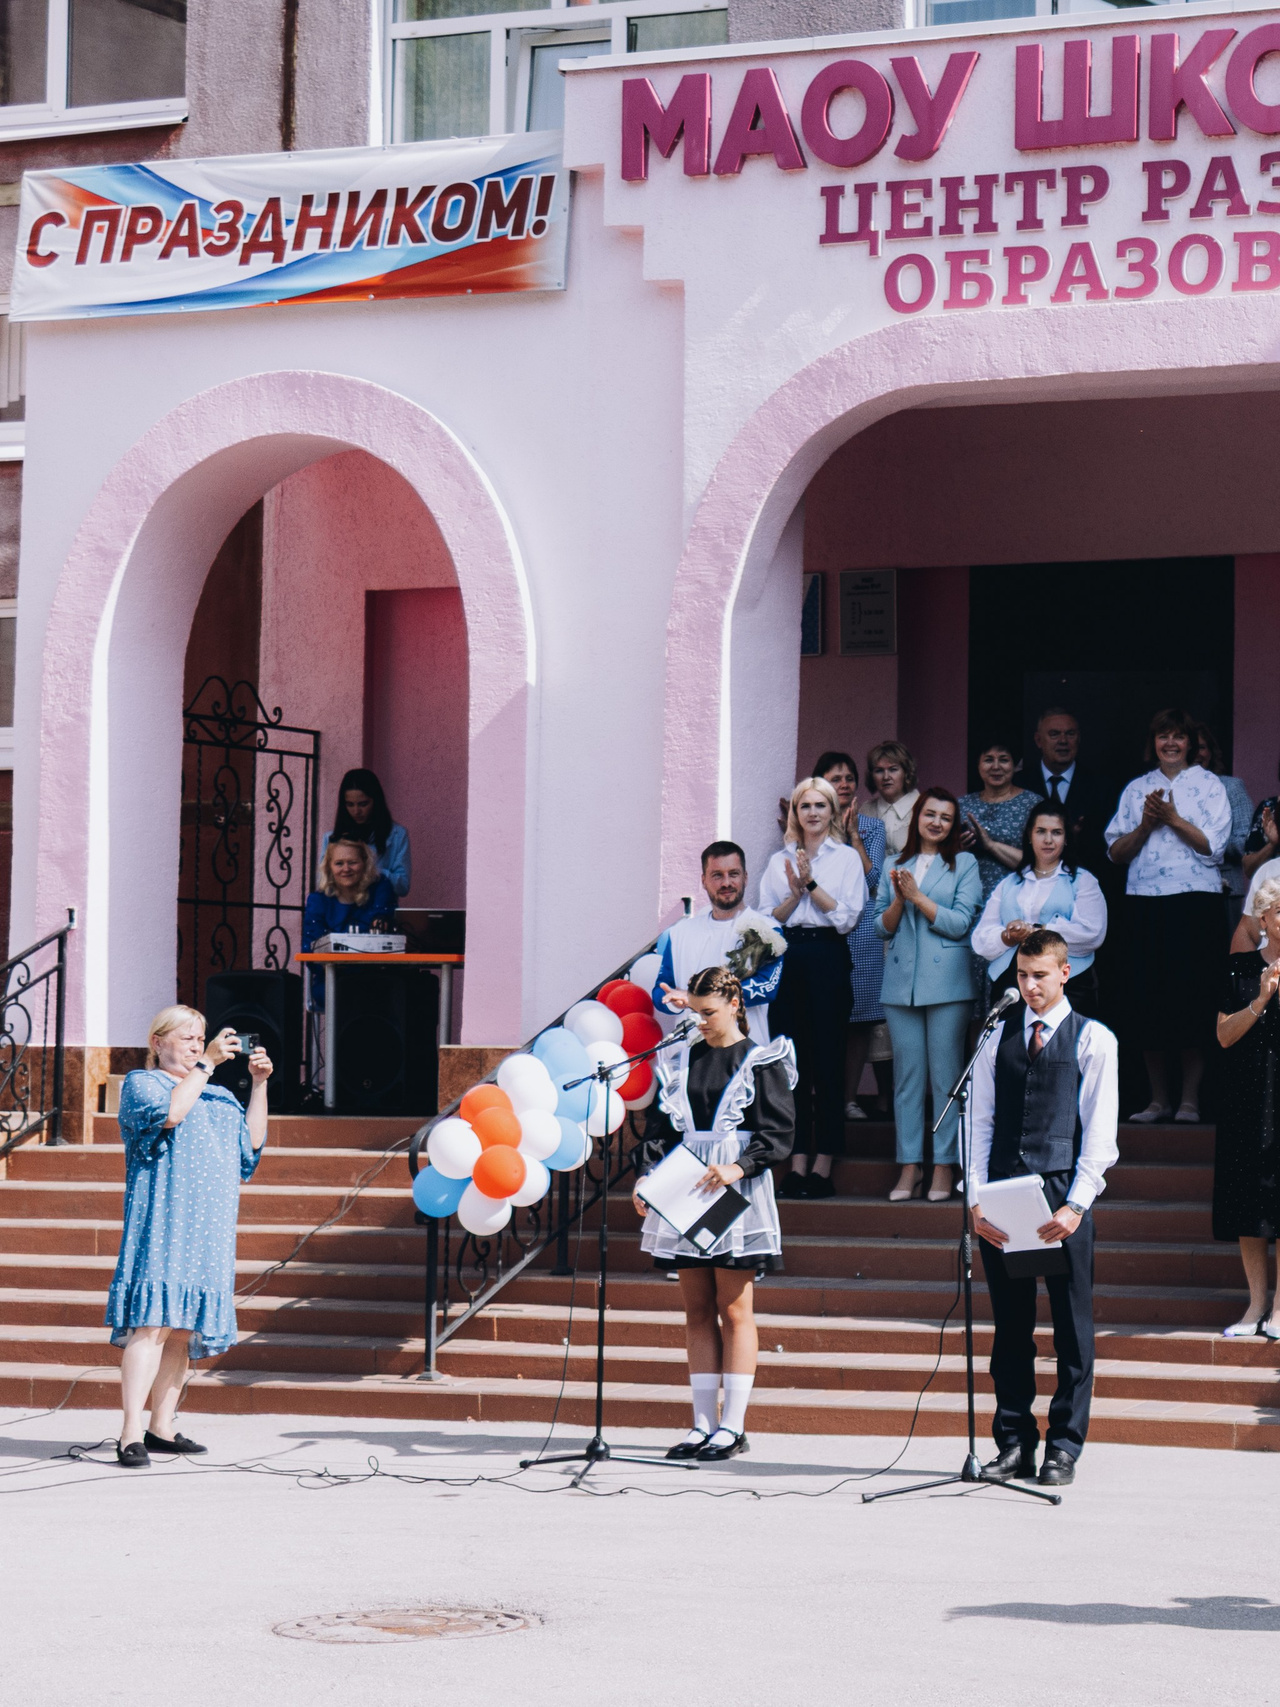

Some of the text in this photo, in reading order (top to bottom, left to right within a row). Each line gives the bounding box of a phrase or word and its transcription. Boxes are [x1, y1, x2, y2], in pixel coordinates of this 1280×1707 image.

[621, 51, 980, 182] МАОУ
[26, 174, 556, 268] С ПРАЗДНИКОМ!
[818, 164, 1111, 257] ЦЕНТР
